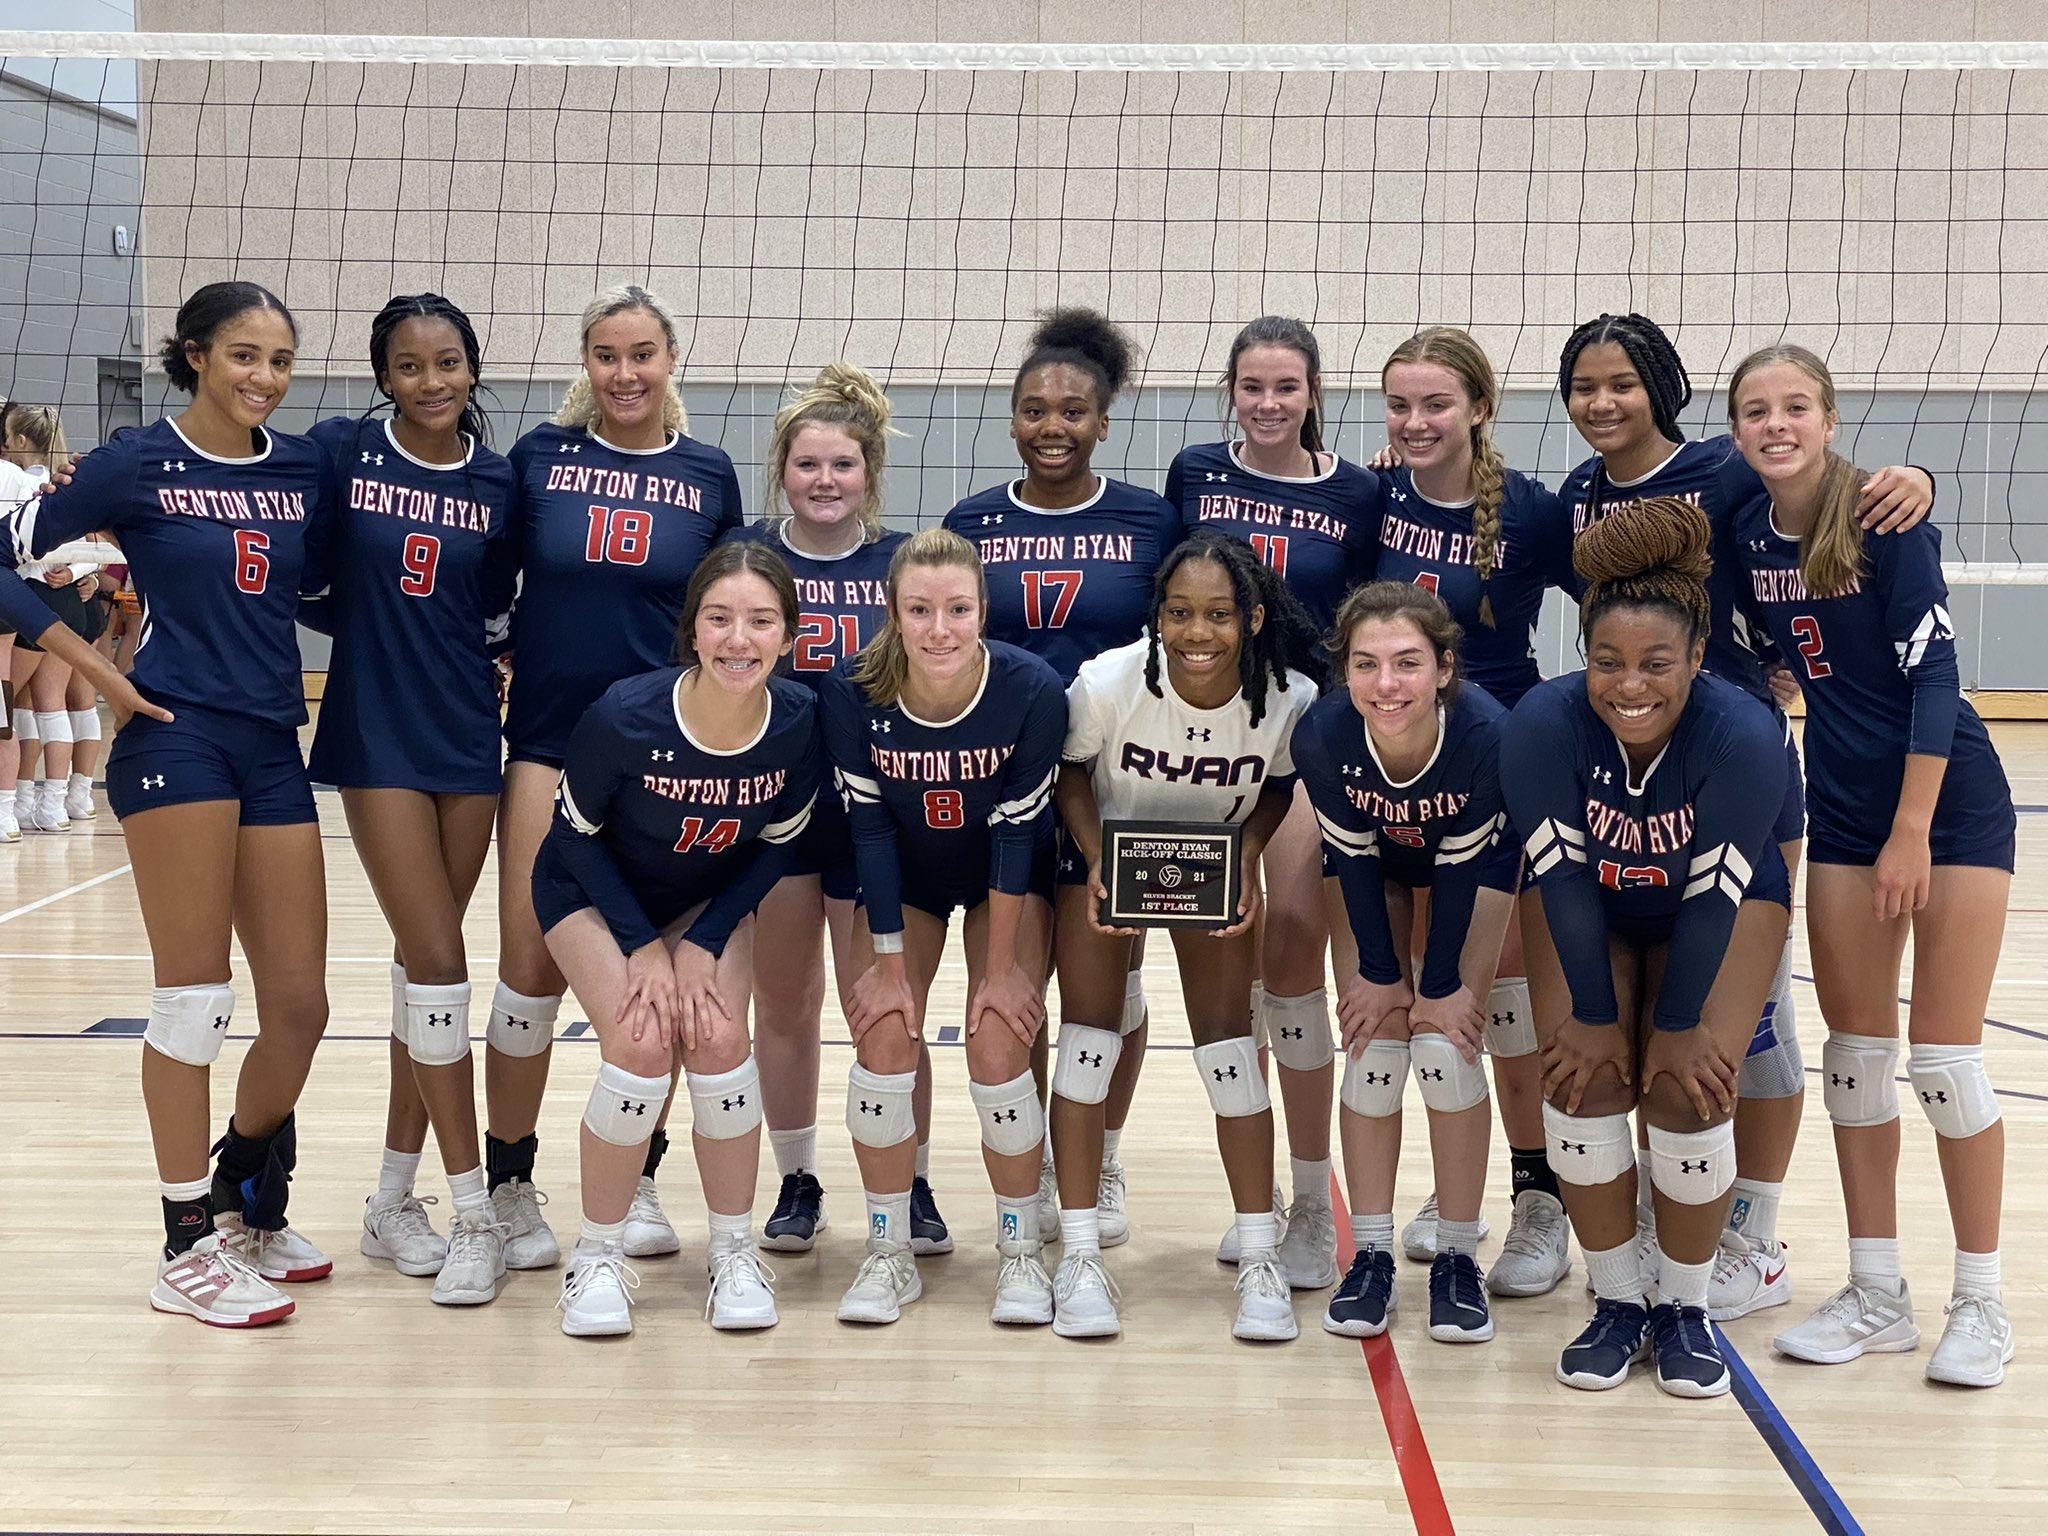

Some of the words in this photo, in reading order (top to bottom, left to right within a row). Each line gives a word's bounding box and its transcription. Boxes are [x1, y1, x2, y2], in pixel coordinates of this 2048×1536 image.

[158, 488, 250, 520] DENTON
[252, 491, 305, 522] RYAN
[350, 478, 438, 523] DENTON
[442, 497, 491, 534] RYAN
[546, 465, 638, 501] DENTON
[644, 476, 702, 513] RYAN
[585, 504, 654, 567] 18
[1199, 495, 1284, 526] DENTON
[1290, 508, 1348, 542] RYAN
[233, 528, 271, 595] 6
[400, 532, 441, 598] 9
[979, 536, 1065, 565] DENTON
[1073, 534, 1133, 562] RYAN
[1447, 533, 1508, 569] RYN
[843, 580, 890, 606] RYA
[1021, 570, 1083, 630] 17
[793, 612, 860, 672] 21
[1791, 615, 1834, 680] 2
[1120, 742, 1266, 787] RYAN
[923, 789, 965, 829] 8
[1345, 785, 1410, 822] ENTON
[673, 816, 741, 854] 14
[1133, 841, 1180, 851] DENTON
[1182, 843, 1211, 852] RYAN
[1382, 825, 1425, 848] 5
[1586, 799, 1643, 854] ENTON
[1121, 849, 1174, 859] KICK-OFF
[1176, 851, 1223, 860] CLASSIC
[1135, 870, 1148, 880] 20
[1193, 872, 1206, 882] 21
[1141, 902, 1161, 911] 1ST
[1163, 903, 1199, 912] PLACE
